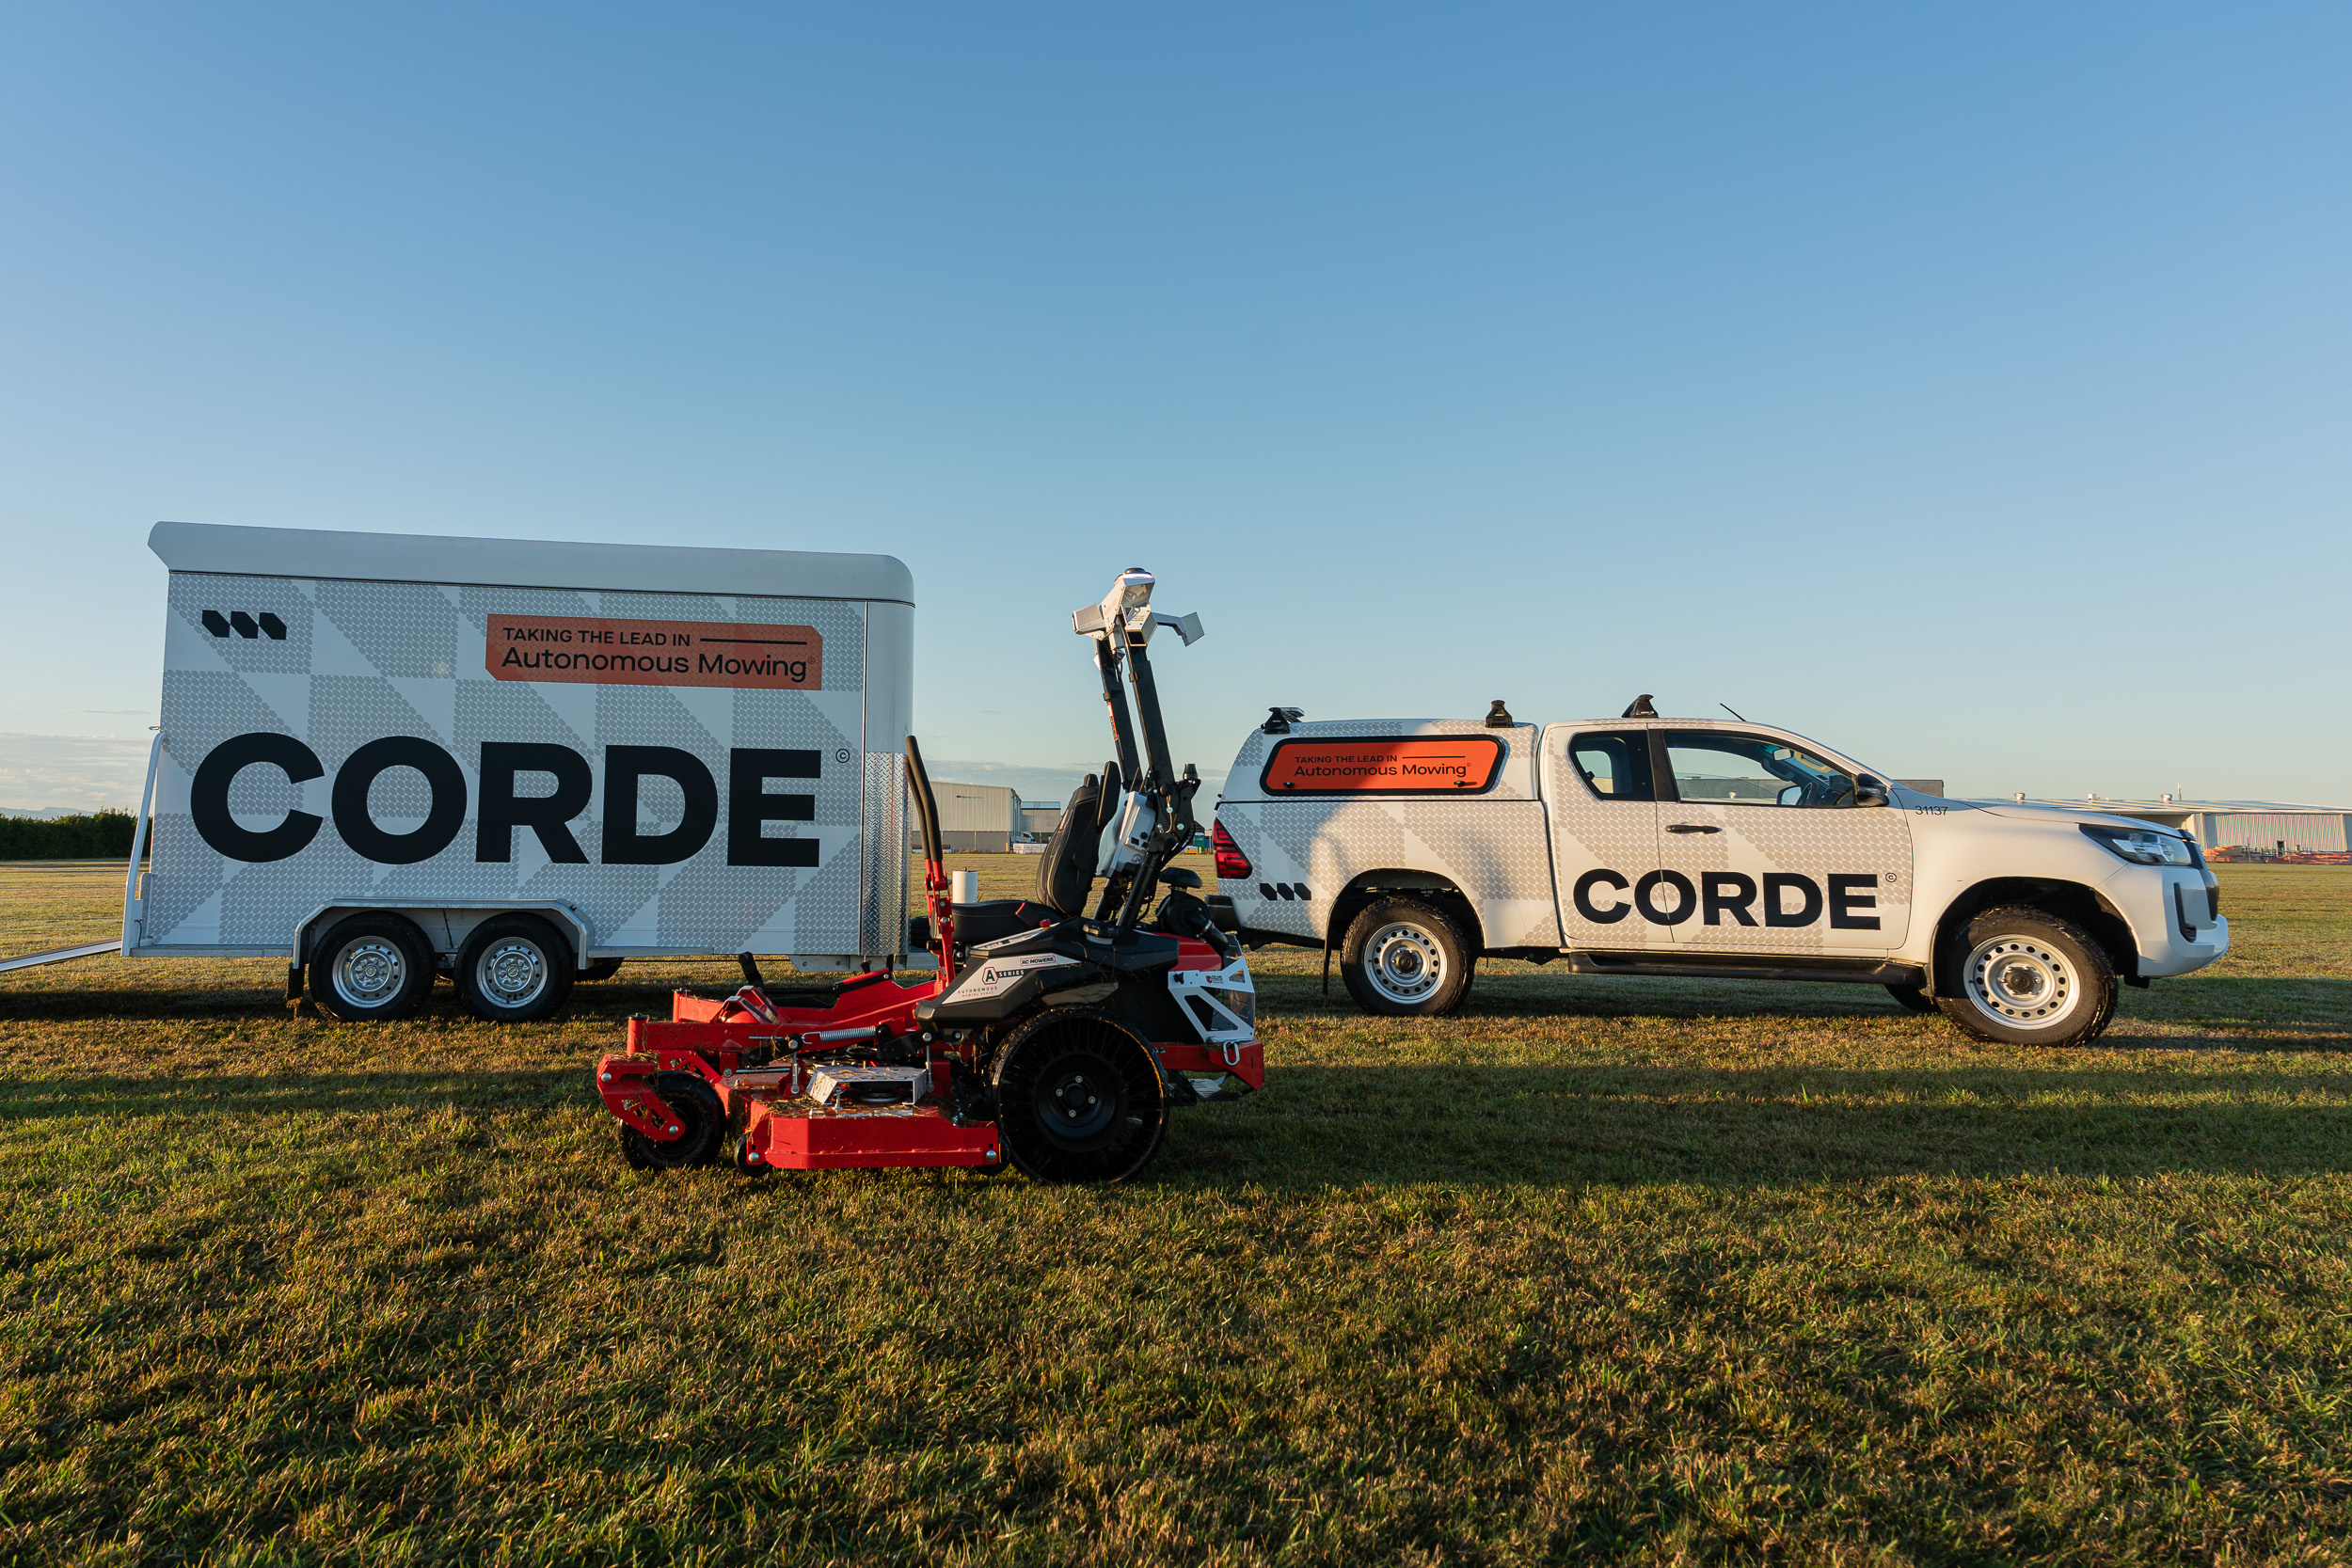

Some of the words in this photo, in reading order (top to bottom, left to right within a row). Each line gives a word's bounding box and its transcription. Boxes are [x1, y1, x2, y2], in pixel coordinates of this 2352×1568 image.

[502, 626, 573, 642] TAKING
[578, 629, 614, 645] THE
[620, 630, 668, 646] LEAD
[672, 632, 691, 647] IN
[501, 645, 691, 674] Autonomous
[697, 652, 806, 684] Mowing
[1295, 755, 1332, 764] TAKING
[1294, 765, 1398, 777] Autonomous
[1402, 764, 1467, 778] Mowing
[190, 732, 822, 868] CORDE
[1915, 805, 1948, 816] 31137
[1574, 868, 1880, 930] CORDE
[985, 970, 995, 982] A
[998, 969, 1025, 977] SERIES
[958, 986, 998, 994] AUTONOMOUS
